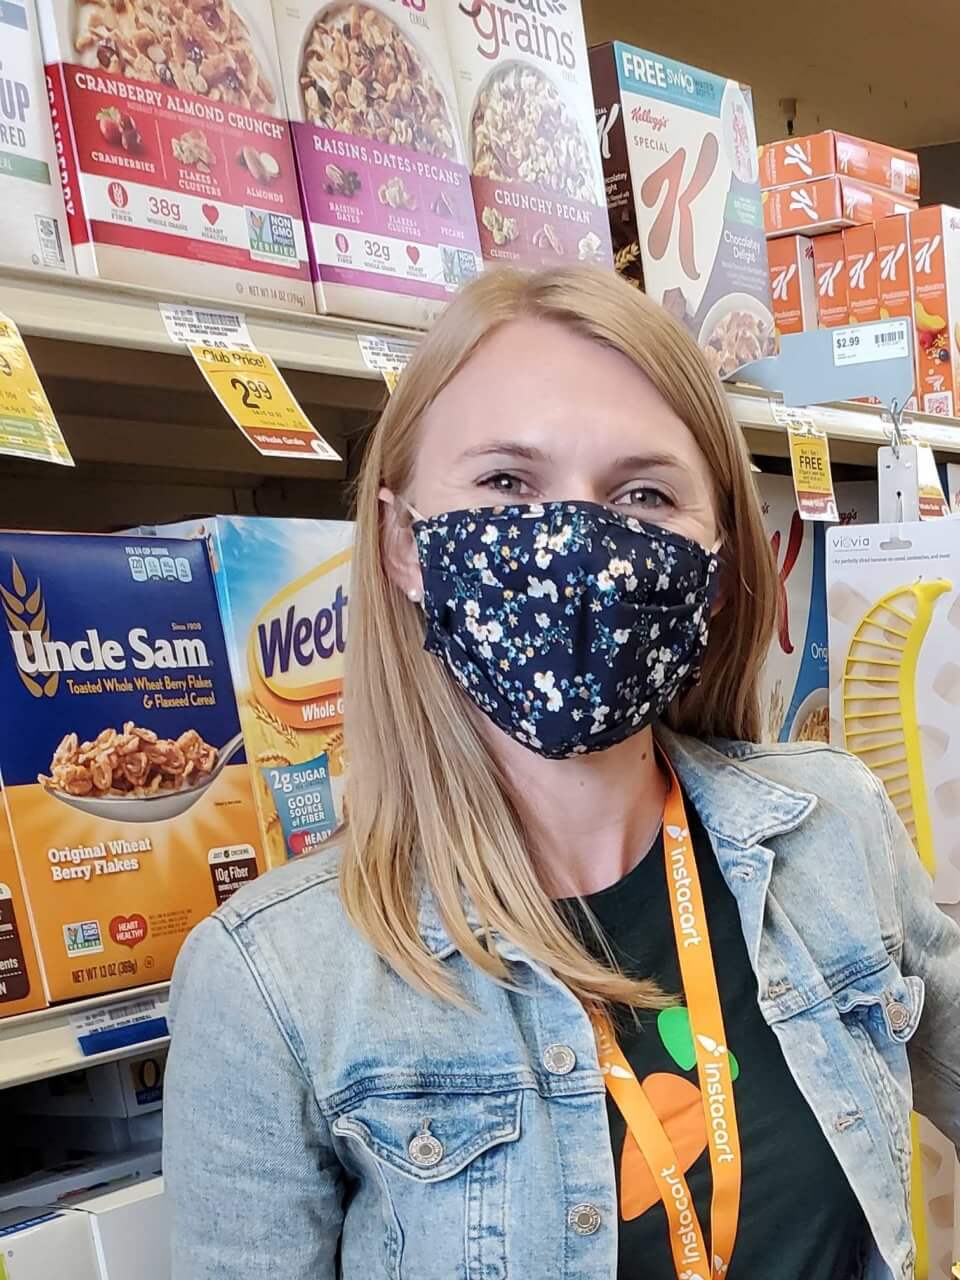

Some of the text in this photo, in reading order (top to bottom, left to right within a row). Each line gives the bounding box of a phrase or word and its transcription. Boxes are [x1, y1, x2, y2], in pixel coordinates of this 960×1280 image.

[75, 73, 163, 108] CRANBERRY
[167, 95, 224, 123] ALMOND
[228, 112, 284, 140] CRUNCH
[631, 105, 669, 129] Kellogg's
[633, 135, 670, 153] SPECIAL
[91, 151, 155, 173] CRANBERRIES
[374, 151, 412, 173] DATES
[417, 161, 462, 187] PECANS
[178, 179, 222, 197] CLUSTERS
[246, 187, 284, 204] ALMONDS
[148, 197, 181, 221] 38g
[494, 190, 591, 224] CRUNCHY PECAN
[641, 131, 718, 281] K
[272, 215, 292, 228] NON
[272, 224, 293, 237] GMO
[364, 240, 391, 262] 32g
[836, 335, 860, 349] $2.99
[799, 455, 823, 471] FREE
[258, 585, 348, 678] Weet
[9, 628, 211, 673] Uncle Sam
[67, 674, 213, 695] Toasted Whole Wheat Berry Flakes
[143, 692, 216, 709] & Flaxseed Cereal
[302, 703, 336, 723] Whole
[270, 767, 326, 793] 2g SUGAR
[287, 792, 321, 809] GOOD
[289, 803, 323, 818] SOURCE
[292, 811, 325, 827] of FIBER
[48, 838, 152, 865] Original Wheat
[51, 857, 139, 882] Berry Flakes
[215, 865, 249, 883] 10g Fiber
[670, 846, 702, 948] instacart
[116, 929, 144, 942] HEALTHY
[118, 920, 139, 932] HEART
[703, 1062, 736, 1164] instacart
[660, 1164, 703, 1268] instacart
